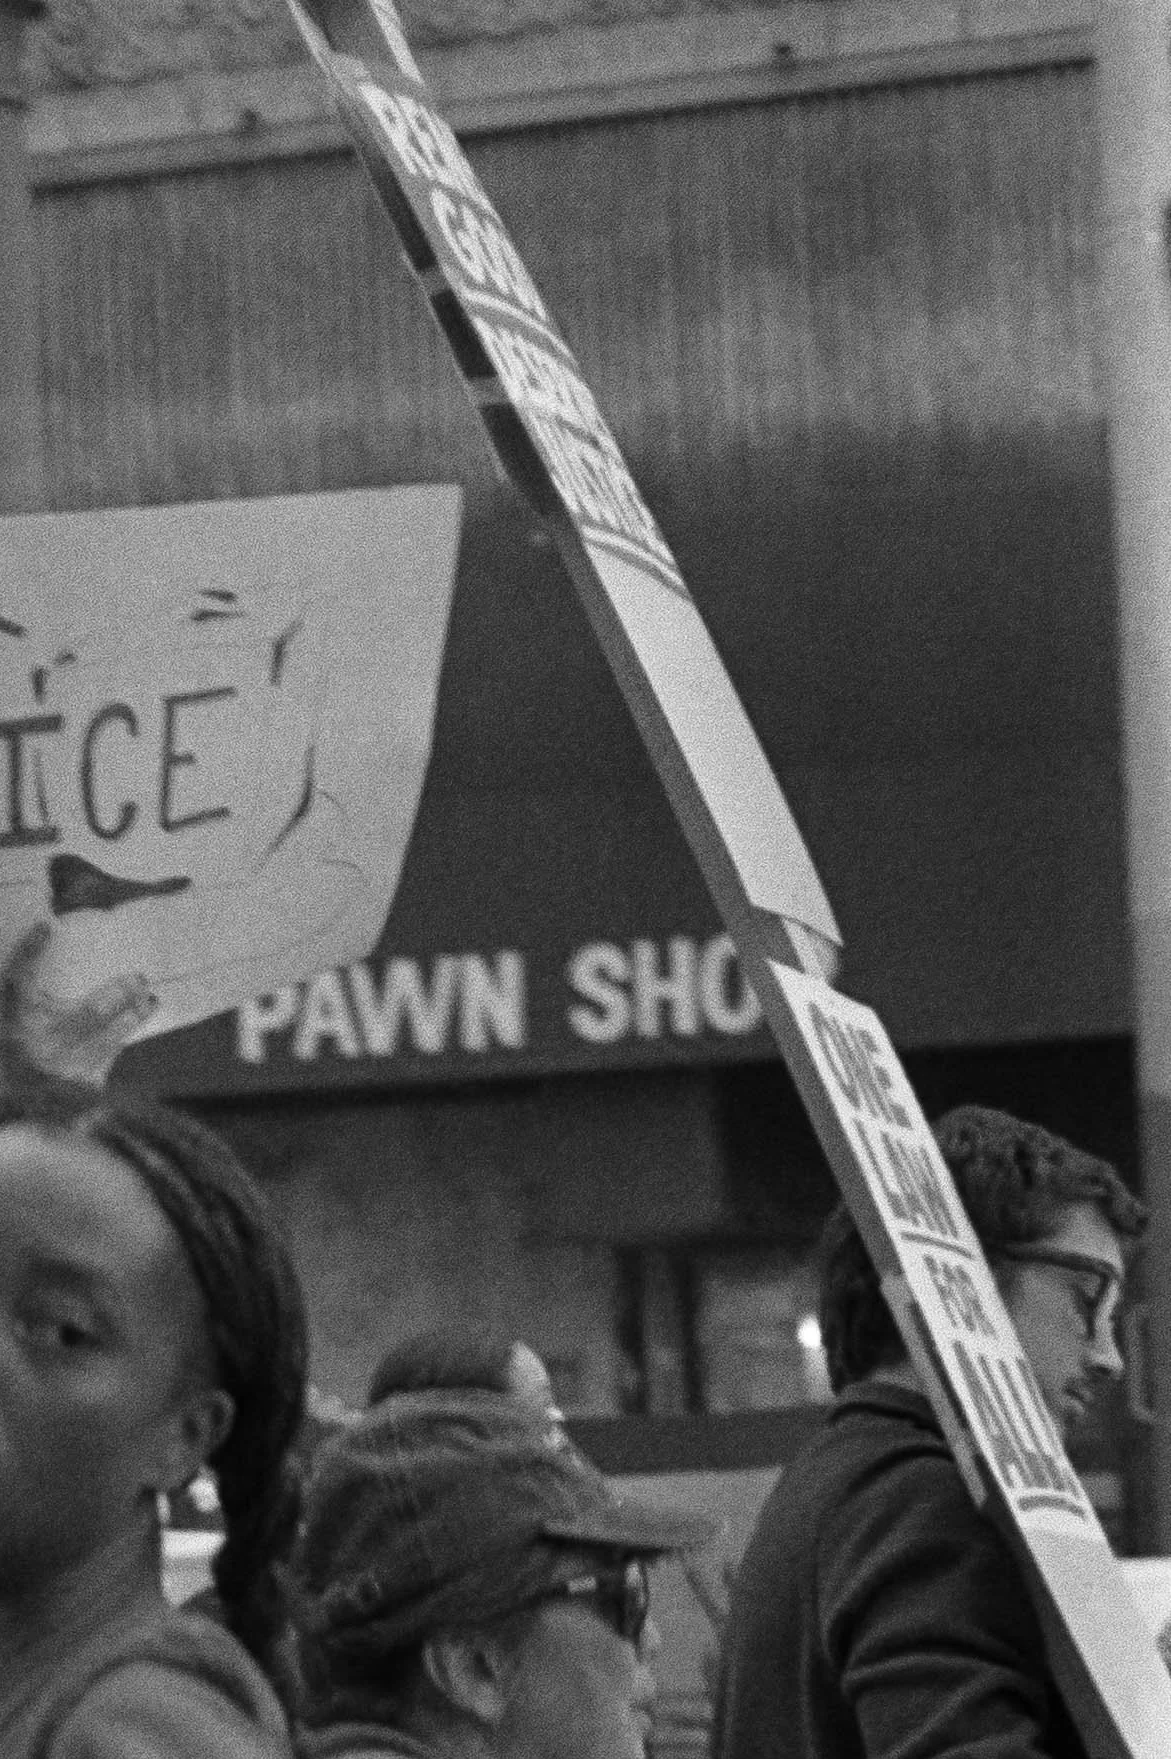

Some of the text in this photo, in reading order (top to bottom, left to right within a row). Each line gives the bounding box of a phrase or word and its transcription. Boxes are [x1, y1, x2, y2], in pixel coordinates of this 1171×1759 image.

[239, 930, 838, 1062] PAWN SHO
[811, 1001, 914, 1129] ONE
[850, 1117, 961, 1240] LAW
[920, 1253, 999, 1339] FOR
